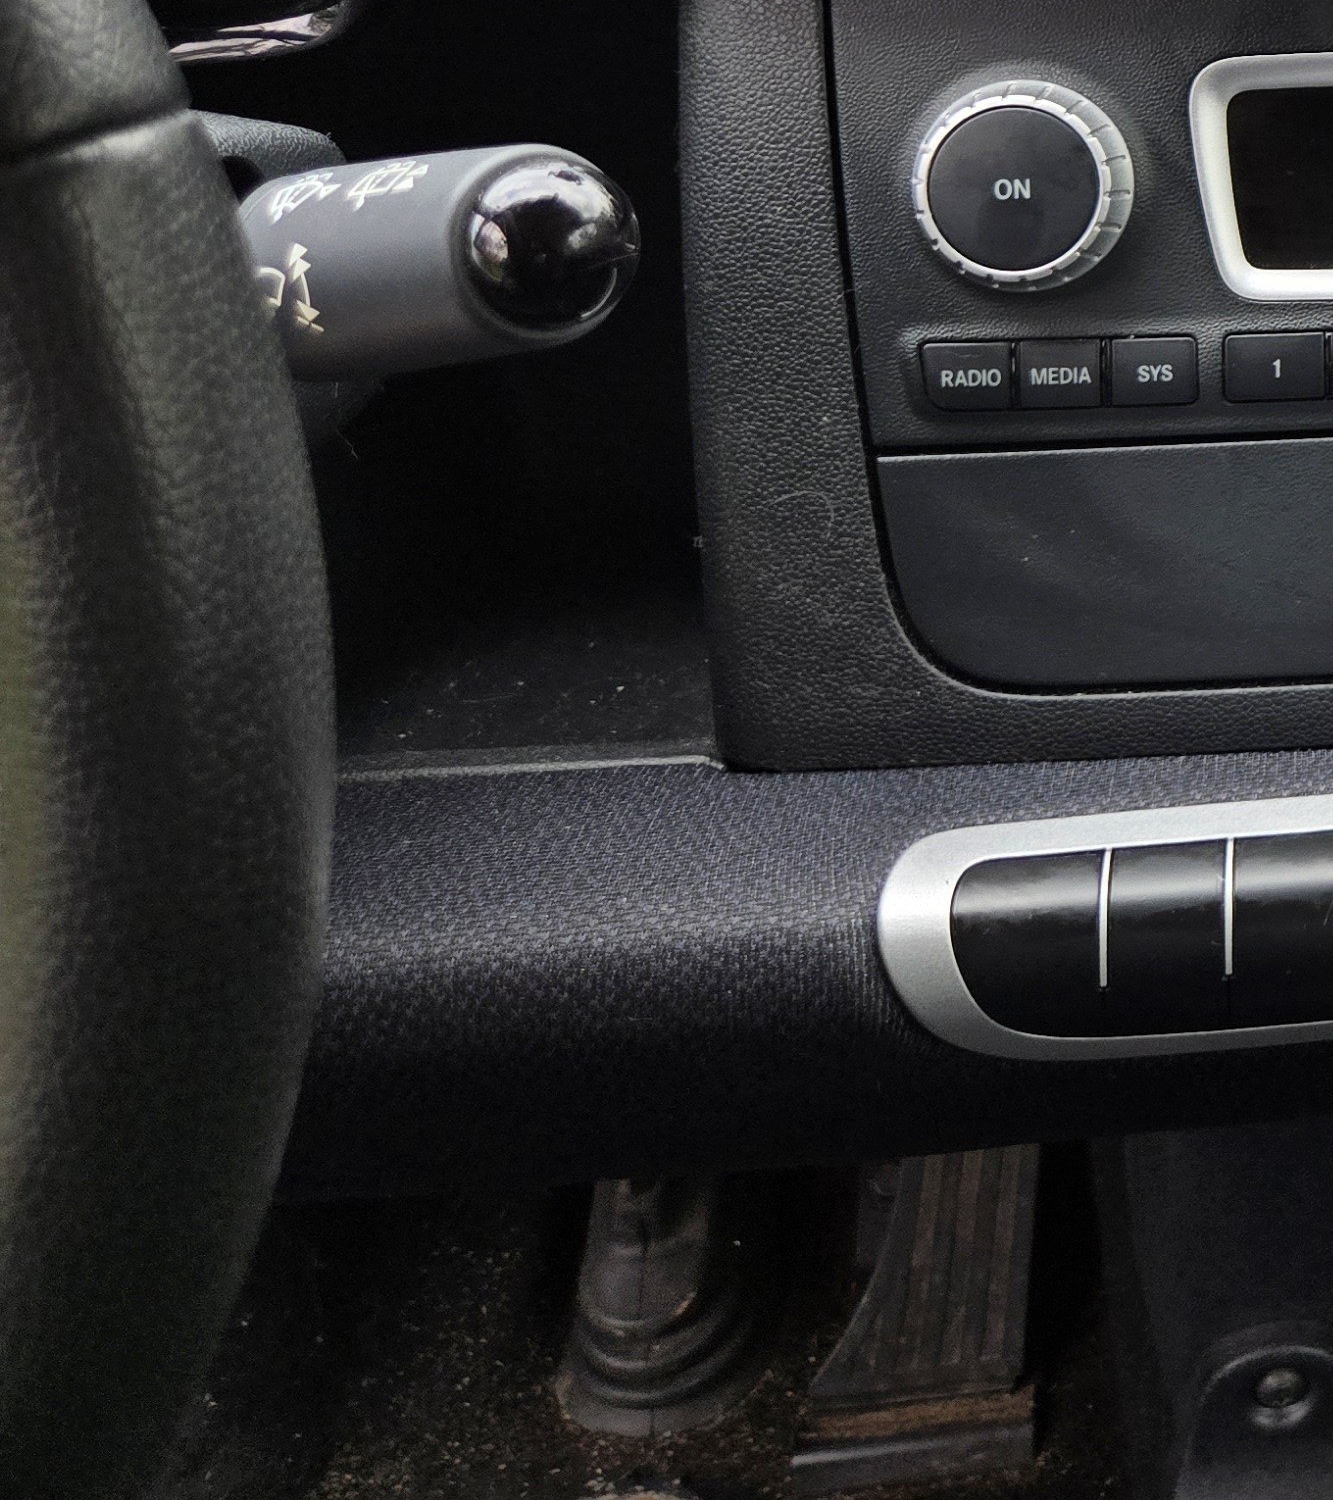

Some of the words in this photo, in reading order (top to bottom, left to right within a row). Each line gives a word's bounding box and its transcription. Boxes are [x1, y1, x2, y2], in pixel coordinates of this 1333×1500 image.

[994, 178, 1031, 200] ON
[940, 368, 1002, 388] RADIO
[1030, 366, 1092, 385] MEDIA
[1137, 364, 1174, 382] SYS
[1272, 359, 1282, 378] 1
